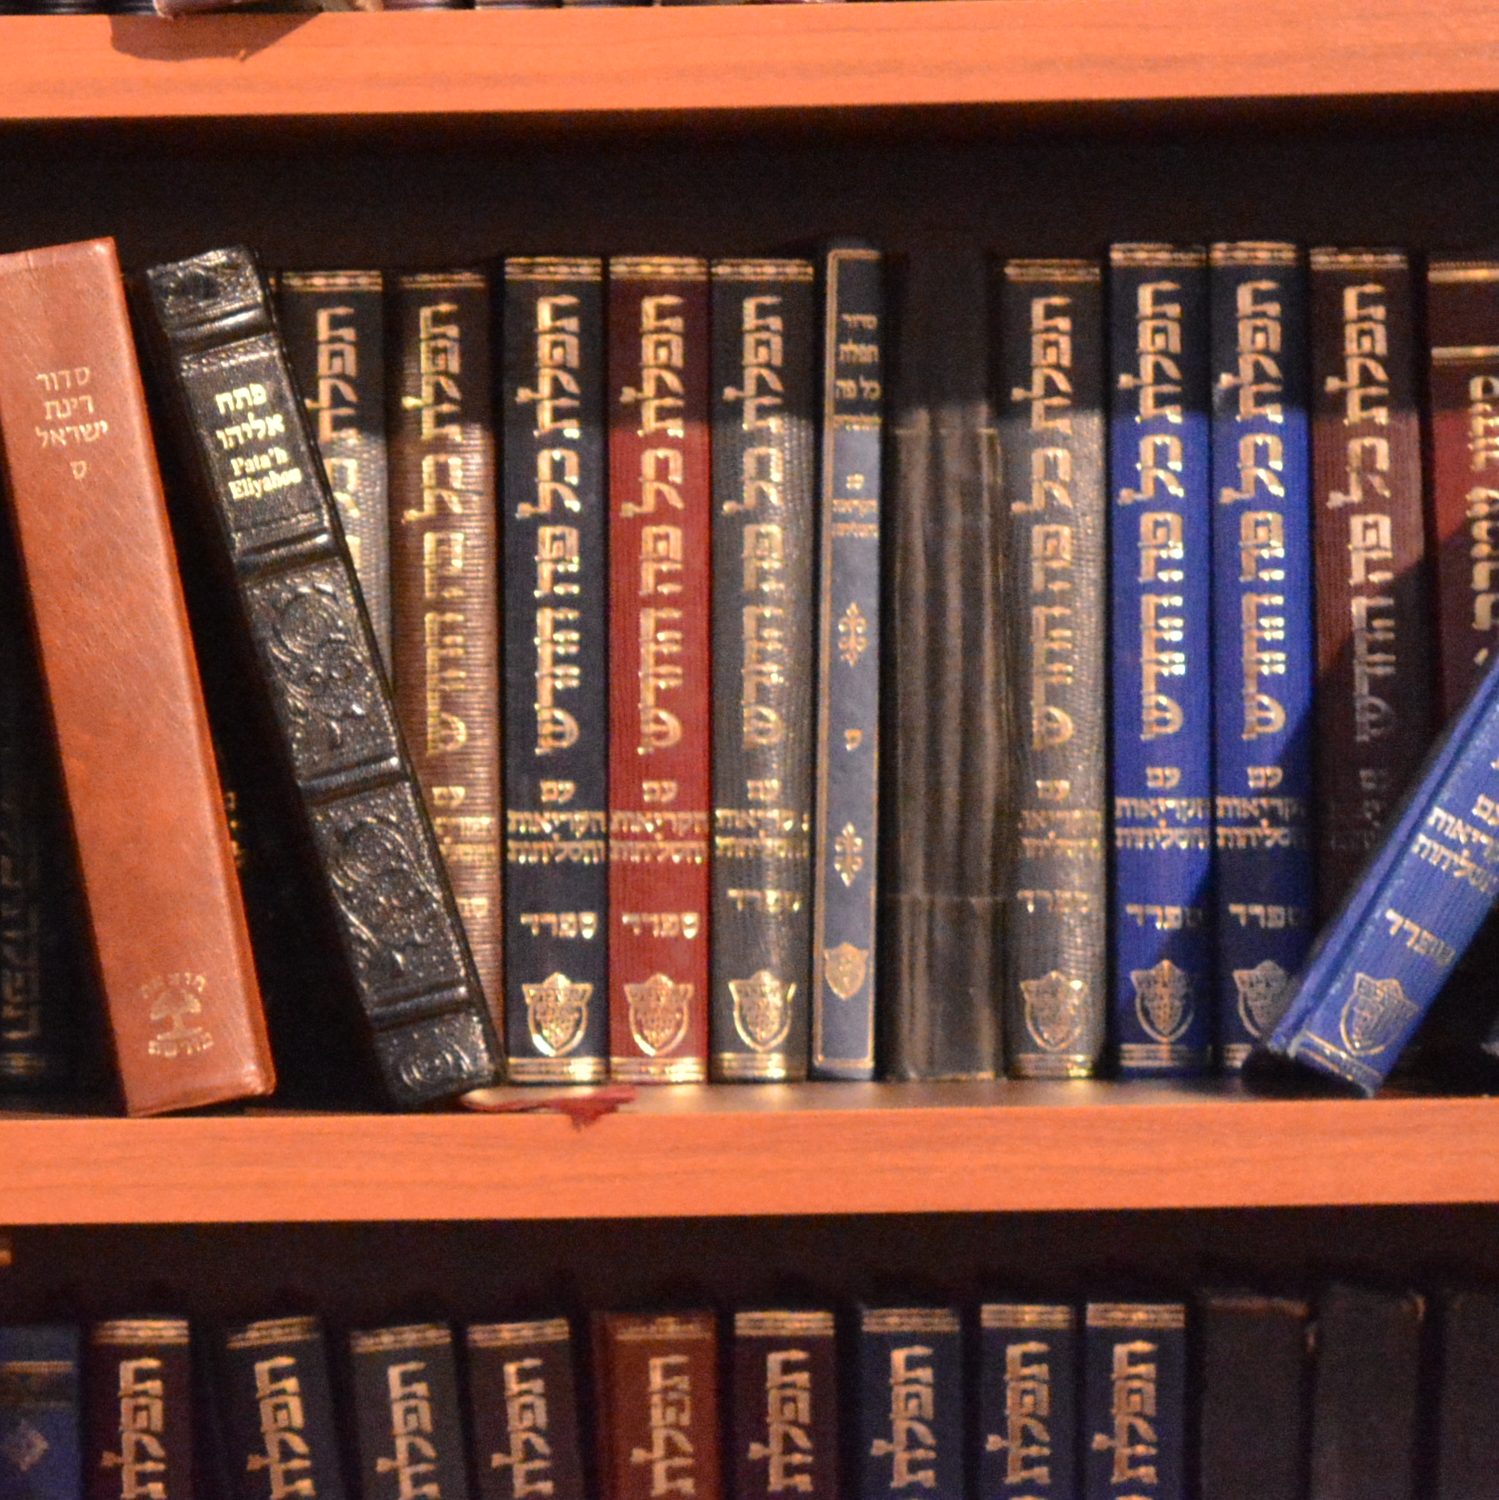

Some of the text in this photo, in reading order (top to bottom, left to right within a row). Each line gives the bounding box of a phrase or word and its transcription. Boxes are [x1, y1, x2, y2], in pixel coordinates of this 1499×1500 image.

[37, 364, 91, 392] סדור
[44, 394, 95, 420] רינת
[215, 383, 267, 415] פתח
[35, 420, 108, 449] ישראל
[216, 412, 285, 449] אליהו
[70, 460, 87, 480] ס
[231, 447, 288, 476] Pata'h
[228, 468, 302, 500] Eliyahou
[620, 294, 683, 756] תפלת כל פה החדש
[102, 1357, 167, 1500] תפלת
[1093, 1339, 1159, 1486] תפלת
